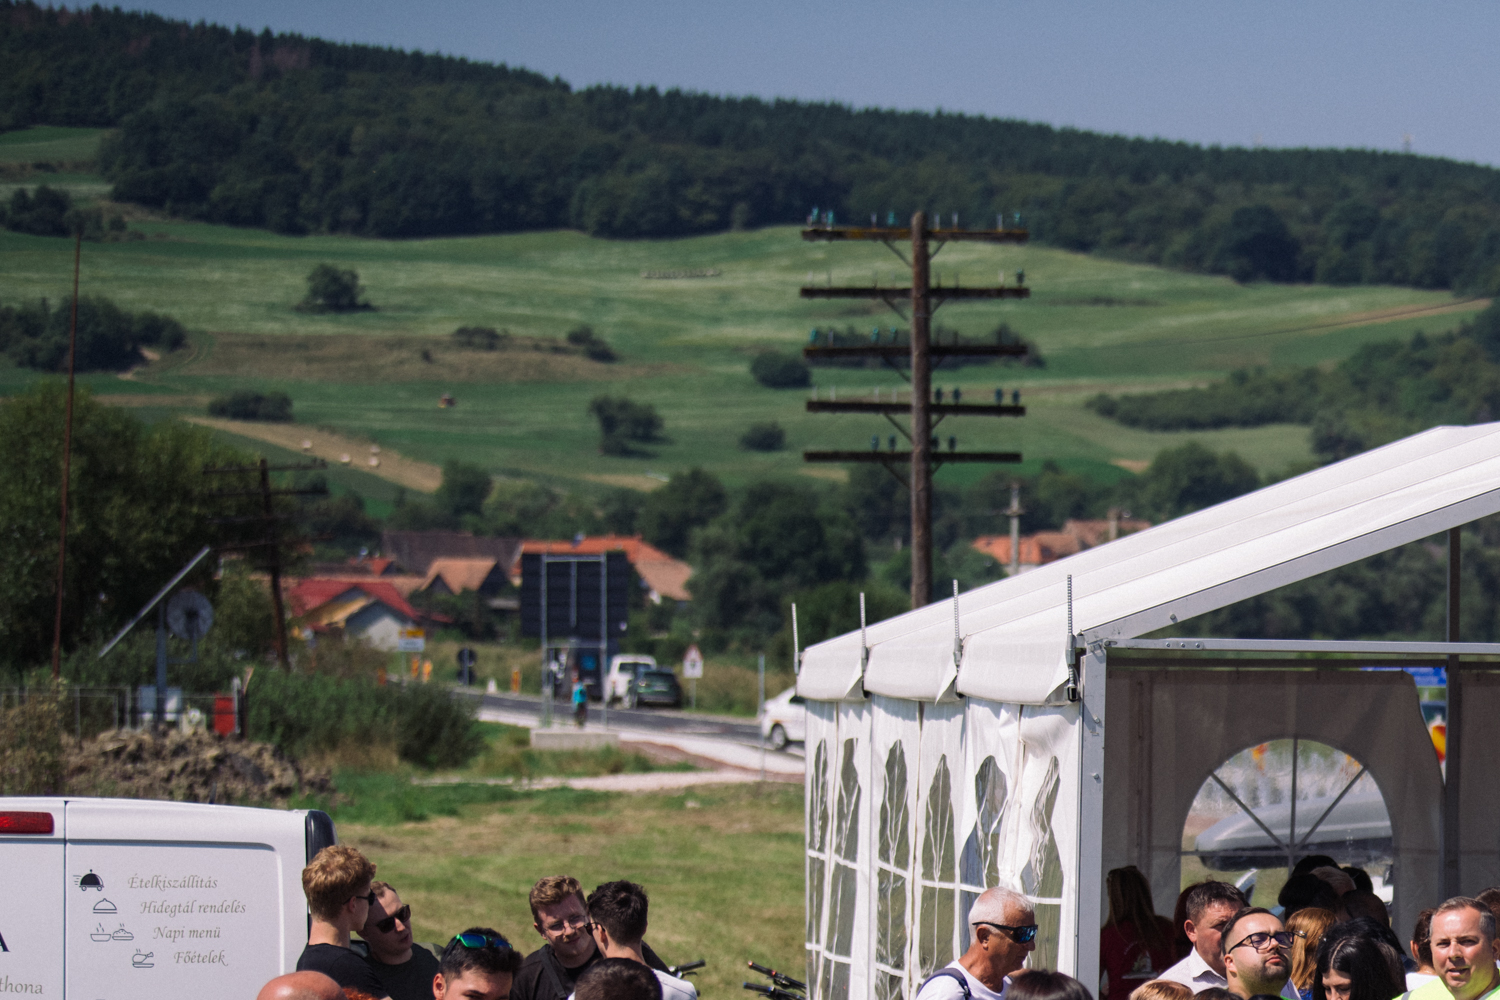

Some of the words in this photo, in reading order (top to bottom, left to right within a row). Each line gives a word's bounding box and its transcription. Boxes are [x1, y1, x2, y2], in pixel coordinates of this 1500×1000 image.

[127, 873, 218, 891] Ételkiszállítás
[140, 900, 194, 918] Hidegtál
[199, 900, 246, 914] rendelés
[153, 926, 185, 943] Napi
[188, 926, 221, 939] menü
[173, 951, 229, 967] Főételek
